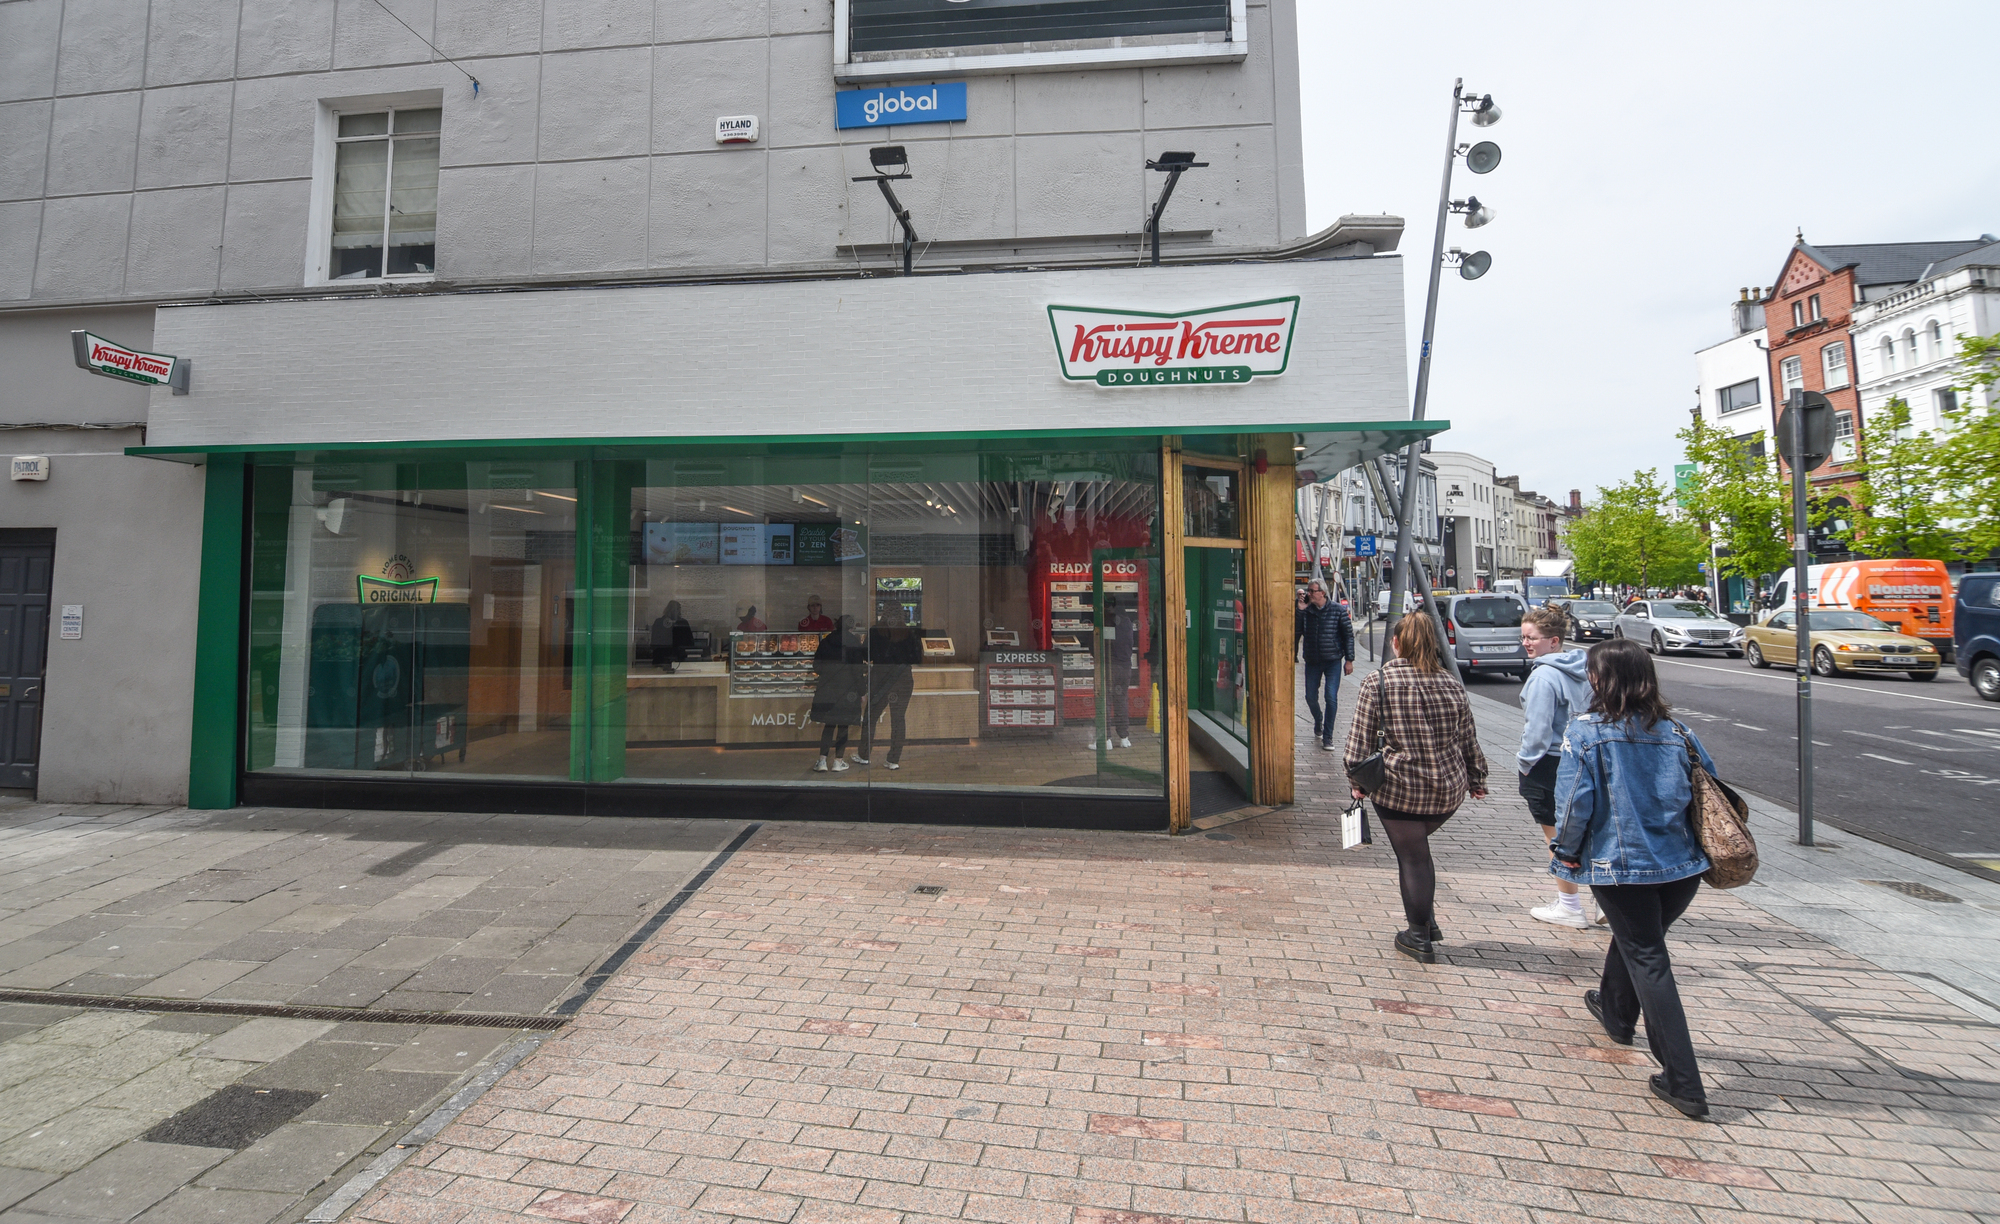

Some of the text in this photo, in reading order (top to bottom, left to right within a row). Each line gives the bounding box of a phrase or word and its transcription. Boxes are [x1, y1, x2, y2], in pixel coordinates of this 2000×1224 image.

[863, 88, 938, 123] global
[720, 120, 752, 129] HYLAND
[1069, 317, 1286, 366] Krispy Kreme
[91, 343, 170, 376] Krispy Kreme
[105, 366, 156, 383] DOUGHNUTS
[1107, 369, 1241, 383] DOUGHNUTS
[14, 461, 40, 473] PATROL
[382, 554, 415, 575] HOME OF THE
[1050, 563, 1092, 574] READY
[1116, 563, 1137, 574] GO
[1868, 584, 1942, 595] Houston
[370, 590, 423, 602] ORIGINAL
[996, 653, 1046, 663] EXPRESS
[751, 713, 796, 725] MADE
